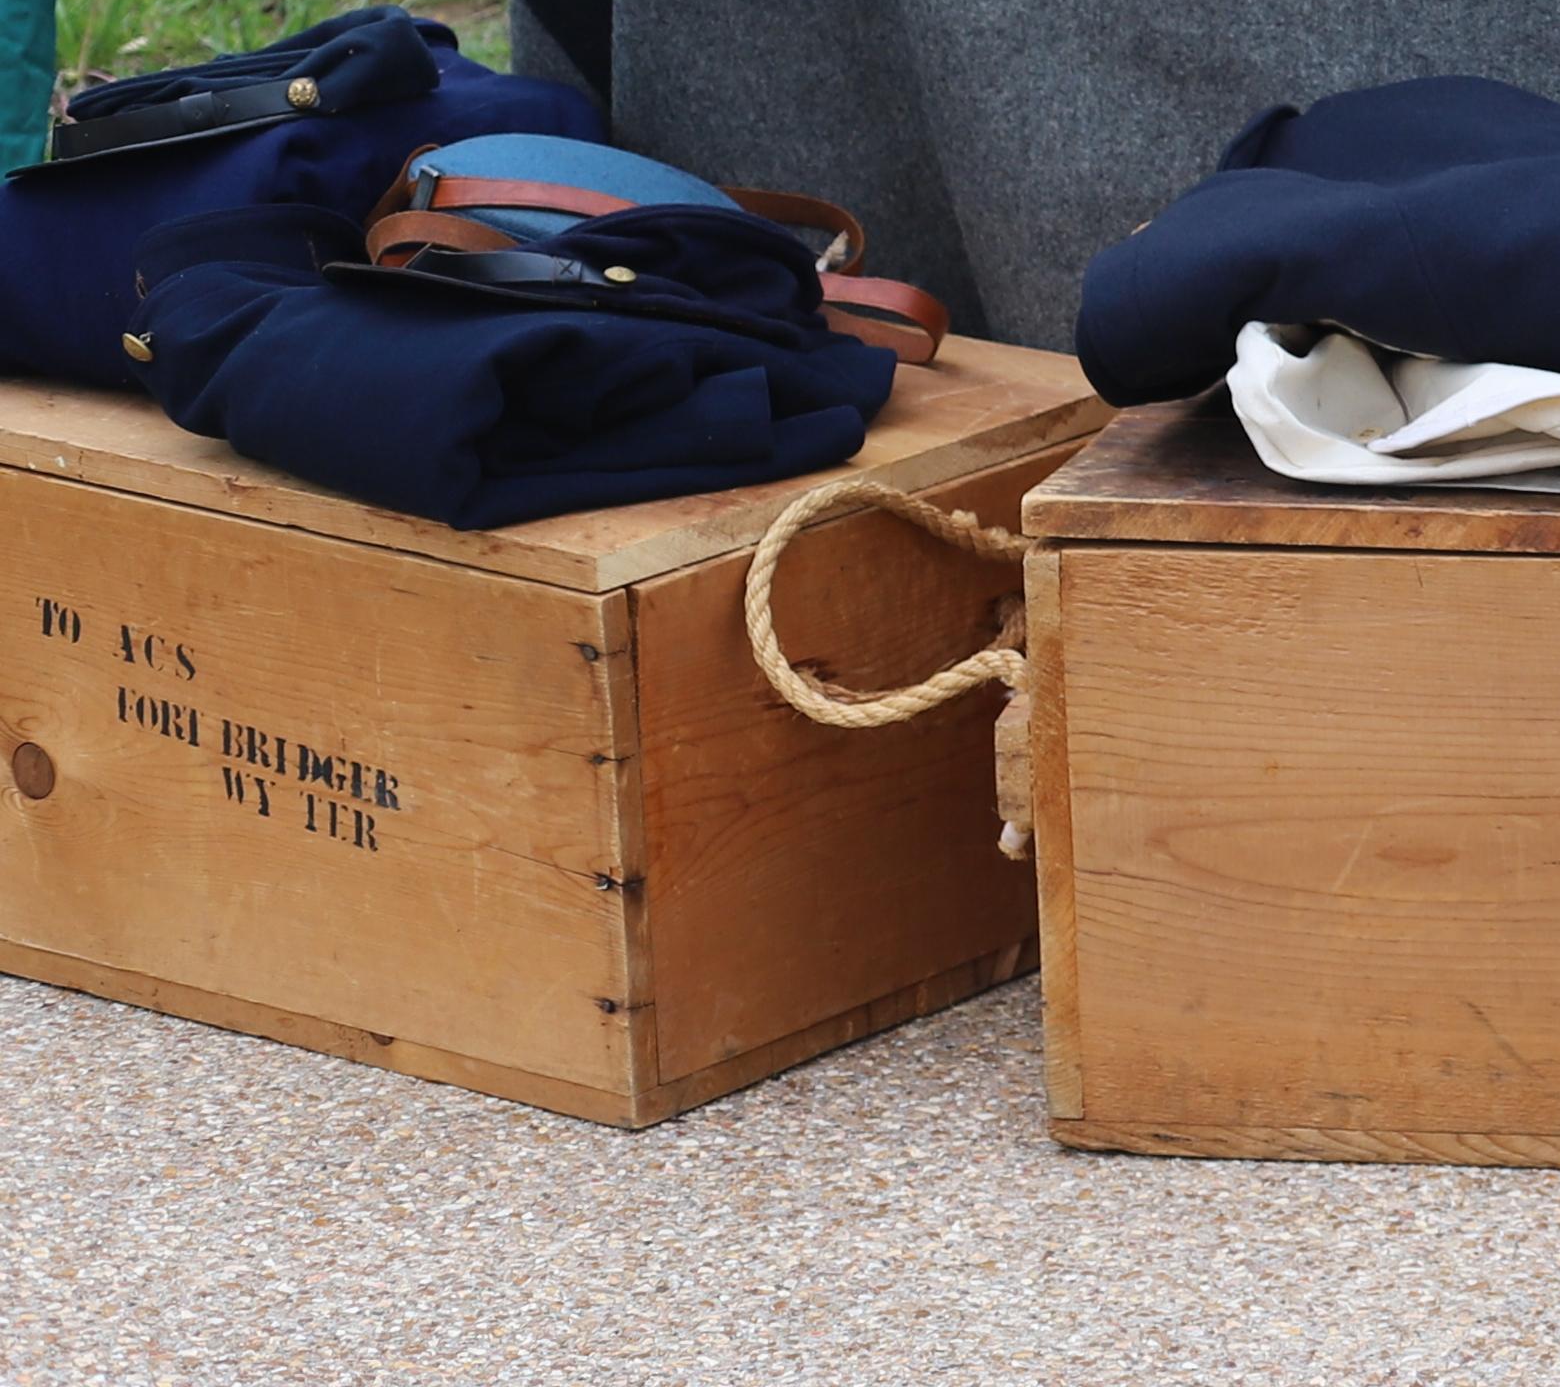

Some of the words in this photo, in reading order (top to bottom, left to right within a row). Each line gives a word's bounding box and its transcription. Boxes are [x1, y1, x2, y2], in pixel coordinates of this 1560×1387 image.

[36, 596, 82, 644] TO
[117, 686, 204, 747] FORT
[221, 718, 402, 812] BRIDGER
[222, 766, 275, 817] WY
[300, 791, 379, 852] TER
